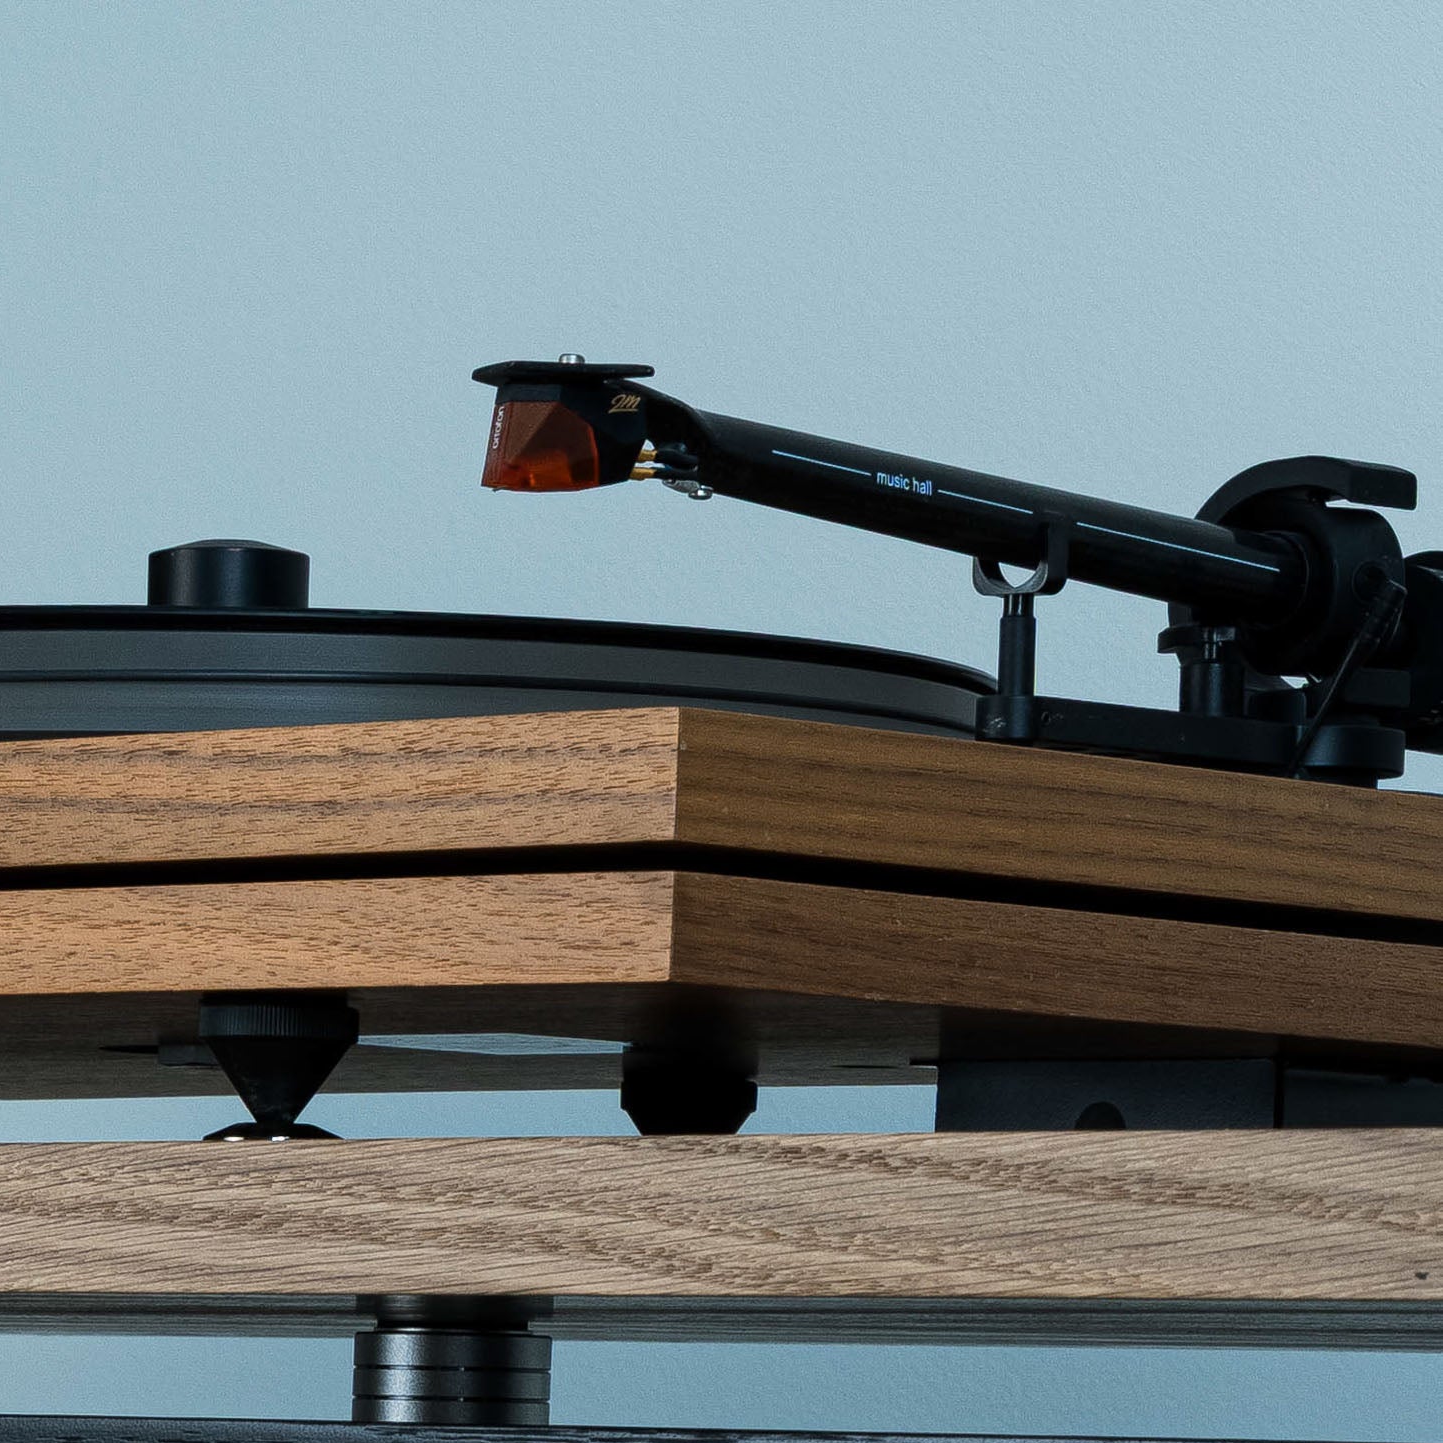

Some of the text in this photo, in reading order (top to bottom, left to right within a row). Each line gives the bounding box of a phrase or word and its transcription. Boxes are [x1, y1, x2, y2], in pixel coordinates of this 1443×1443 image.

[491, 405, 506, 450] ortofon
[876, 471, 933, 497] music hall
